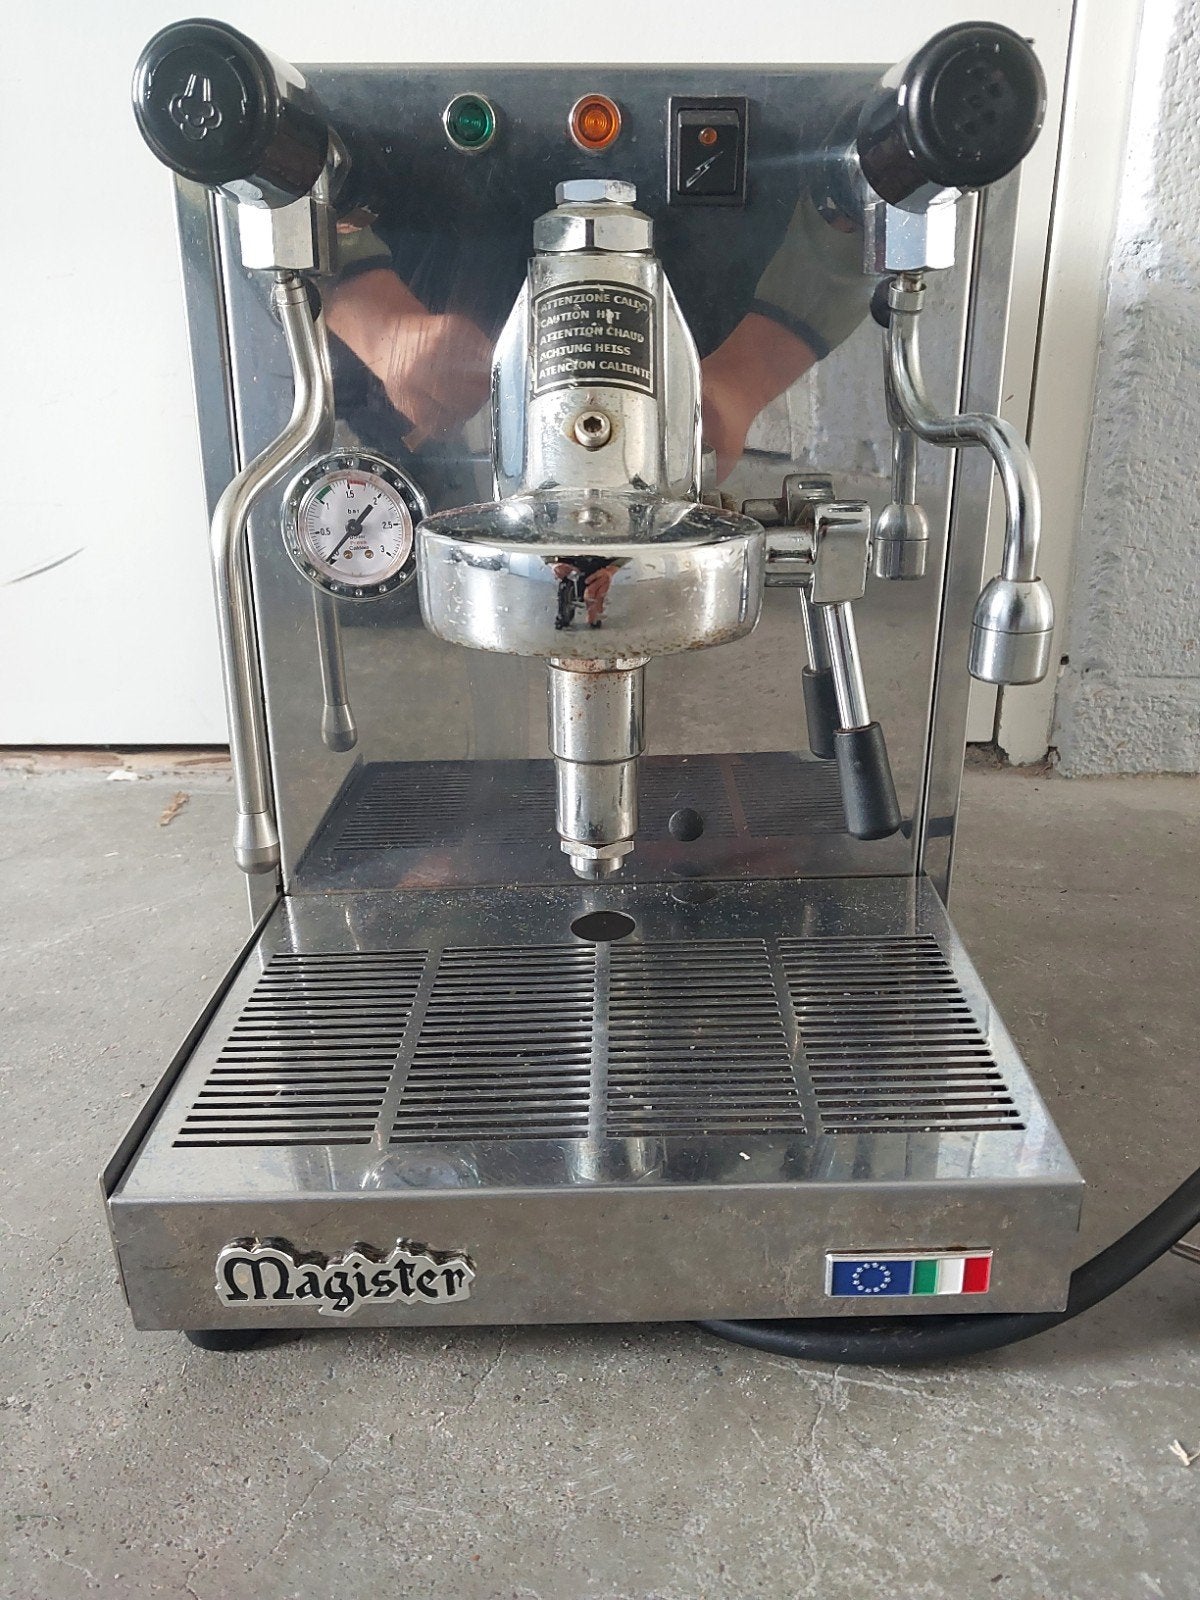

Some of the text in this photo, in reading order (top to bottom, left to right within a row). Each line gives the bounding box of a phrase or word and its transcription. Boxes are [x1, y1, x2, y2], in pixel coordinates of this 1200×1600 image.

[541, 294, 648, 312] ATTENZIONE CALDO
[541, 310, 590, 328] CAUTION
[540, 327, 645, 345] ATTENTION CHAUD
[540, 344, 631, 362] ACHTUNG HEISS
[600, 361, 652, 379] CALIENTE
[373, 497, 378, 505] 2
[320, 528, 331, 536] 0.5
[382, 521, 392, 529] 2.5
[380, 545, 385, 553] 3
[224, 1256, 466, 1311] Magister
